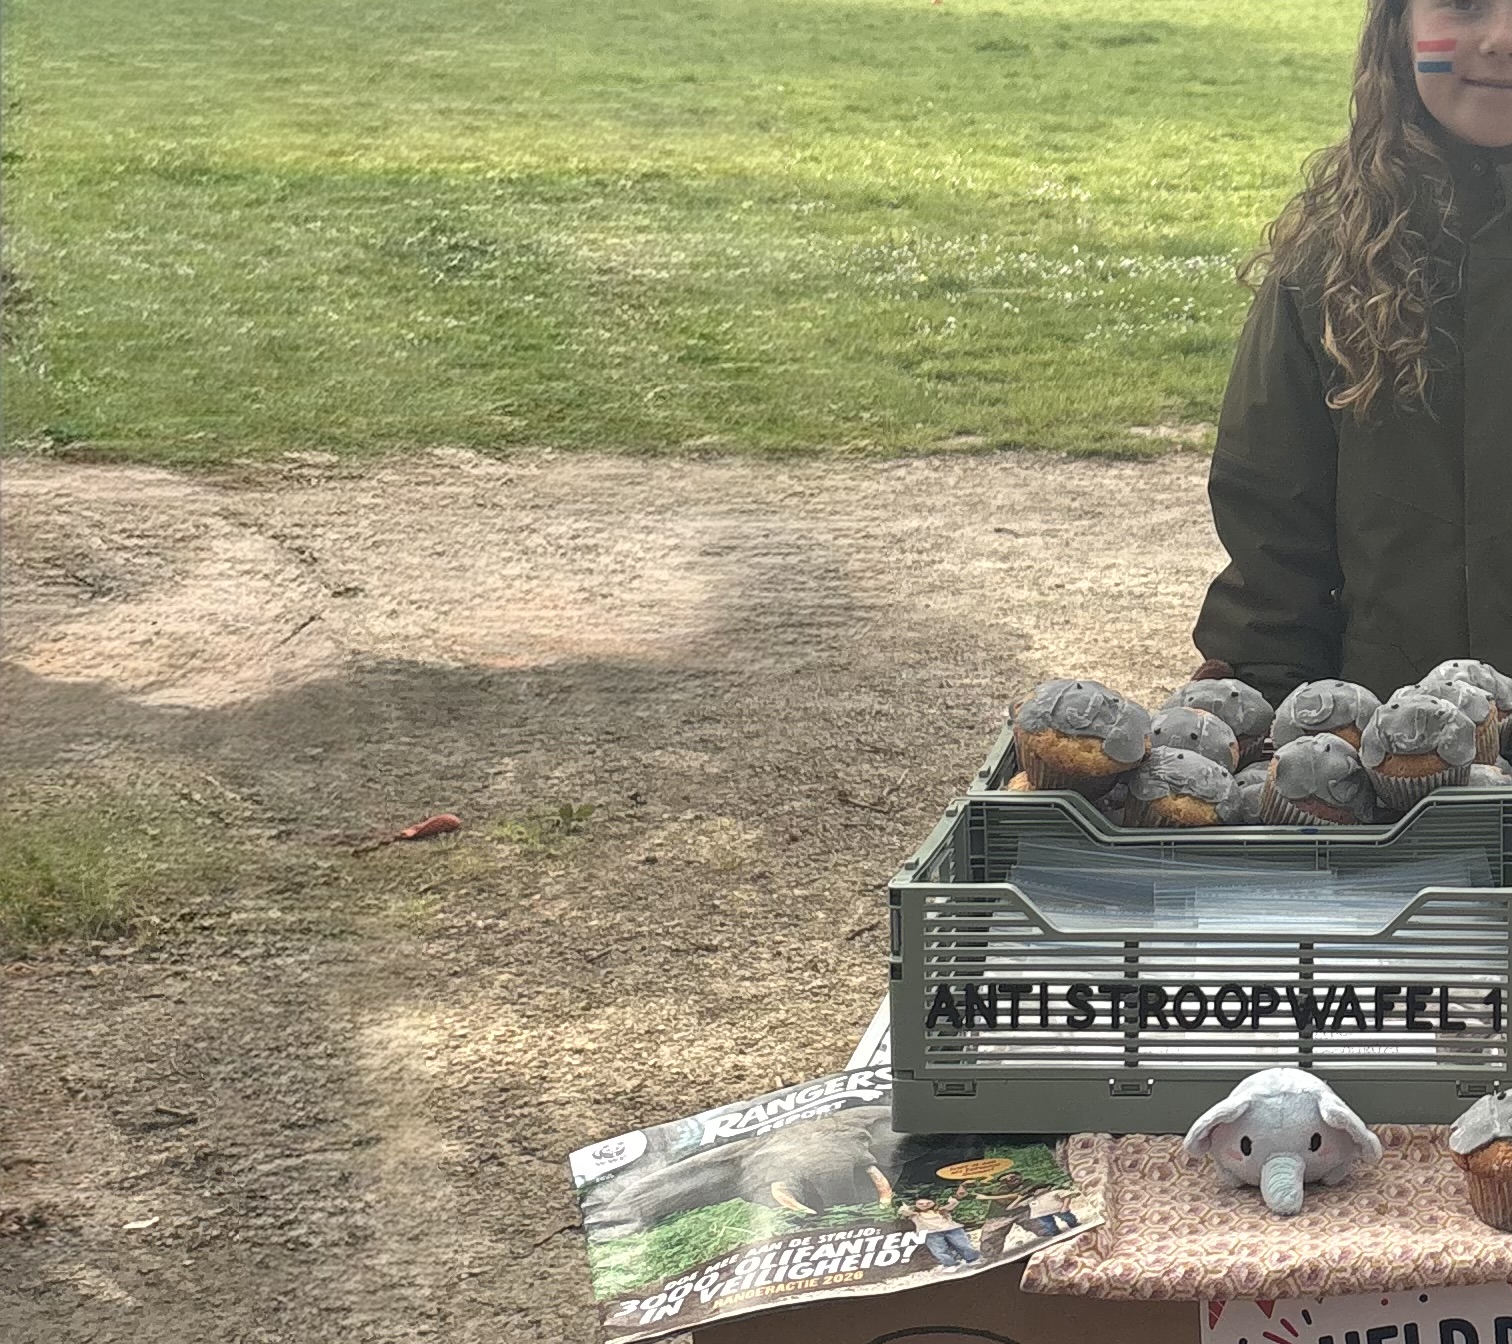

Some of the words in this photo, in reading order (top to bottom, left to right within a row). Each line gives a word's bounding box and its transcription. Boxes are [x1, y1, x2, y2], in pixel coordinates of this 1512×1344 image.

[1483, 987, 1502, 1030] 1
[700, 1066, 893, 1146] RANGERS
[613, 1271, 720, 1318] 3000
[734, 1229, 930, 1275] OLIFANTEN
[639, 1300, 682, 1326] IN
[699, 1244, 919, 1305] VEILIGHEID!
